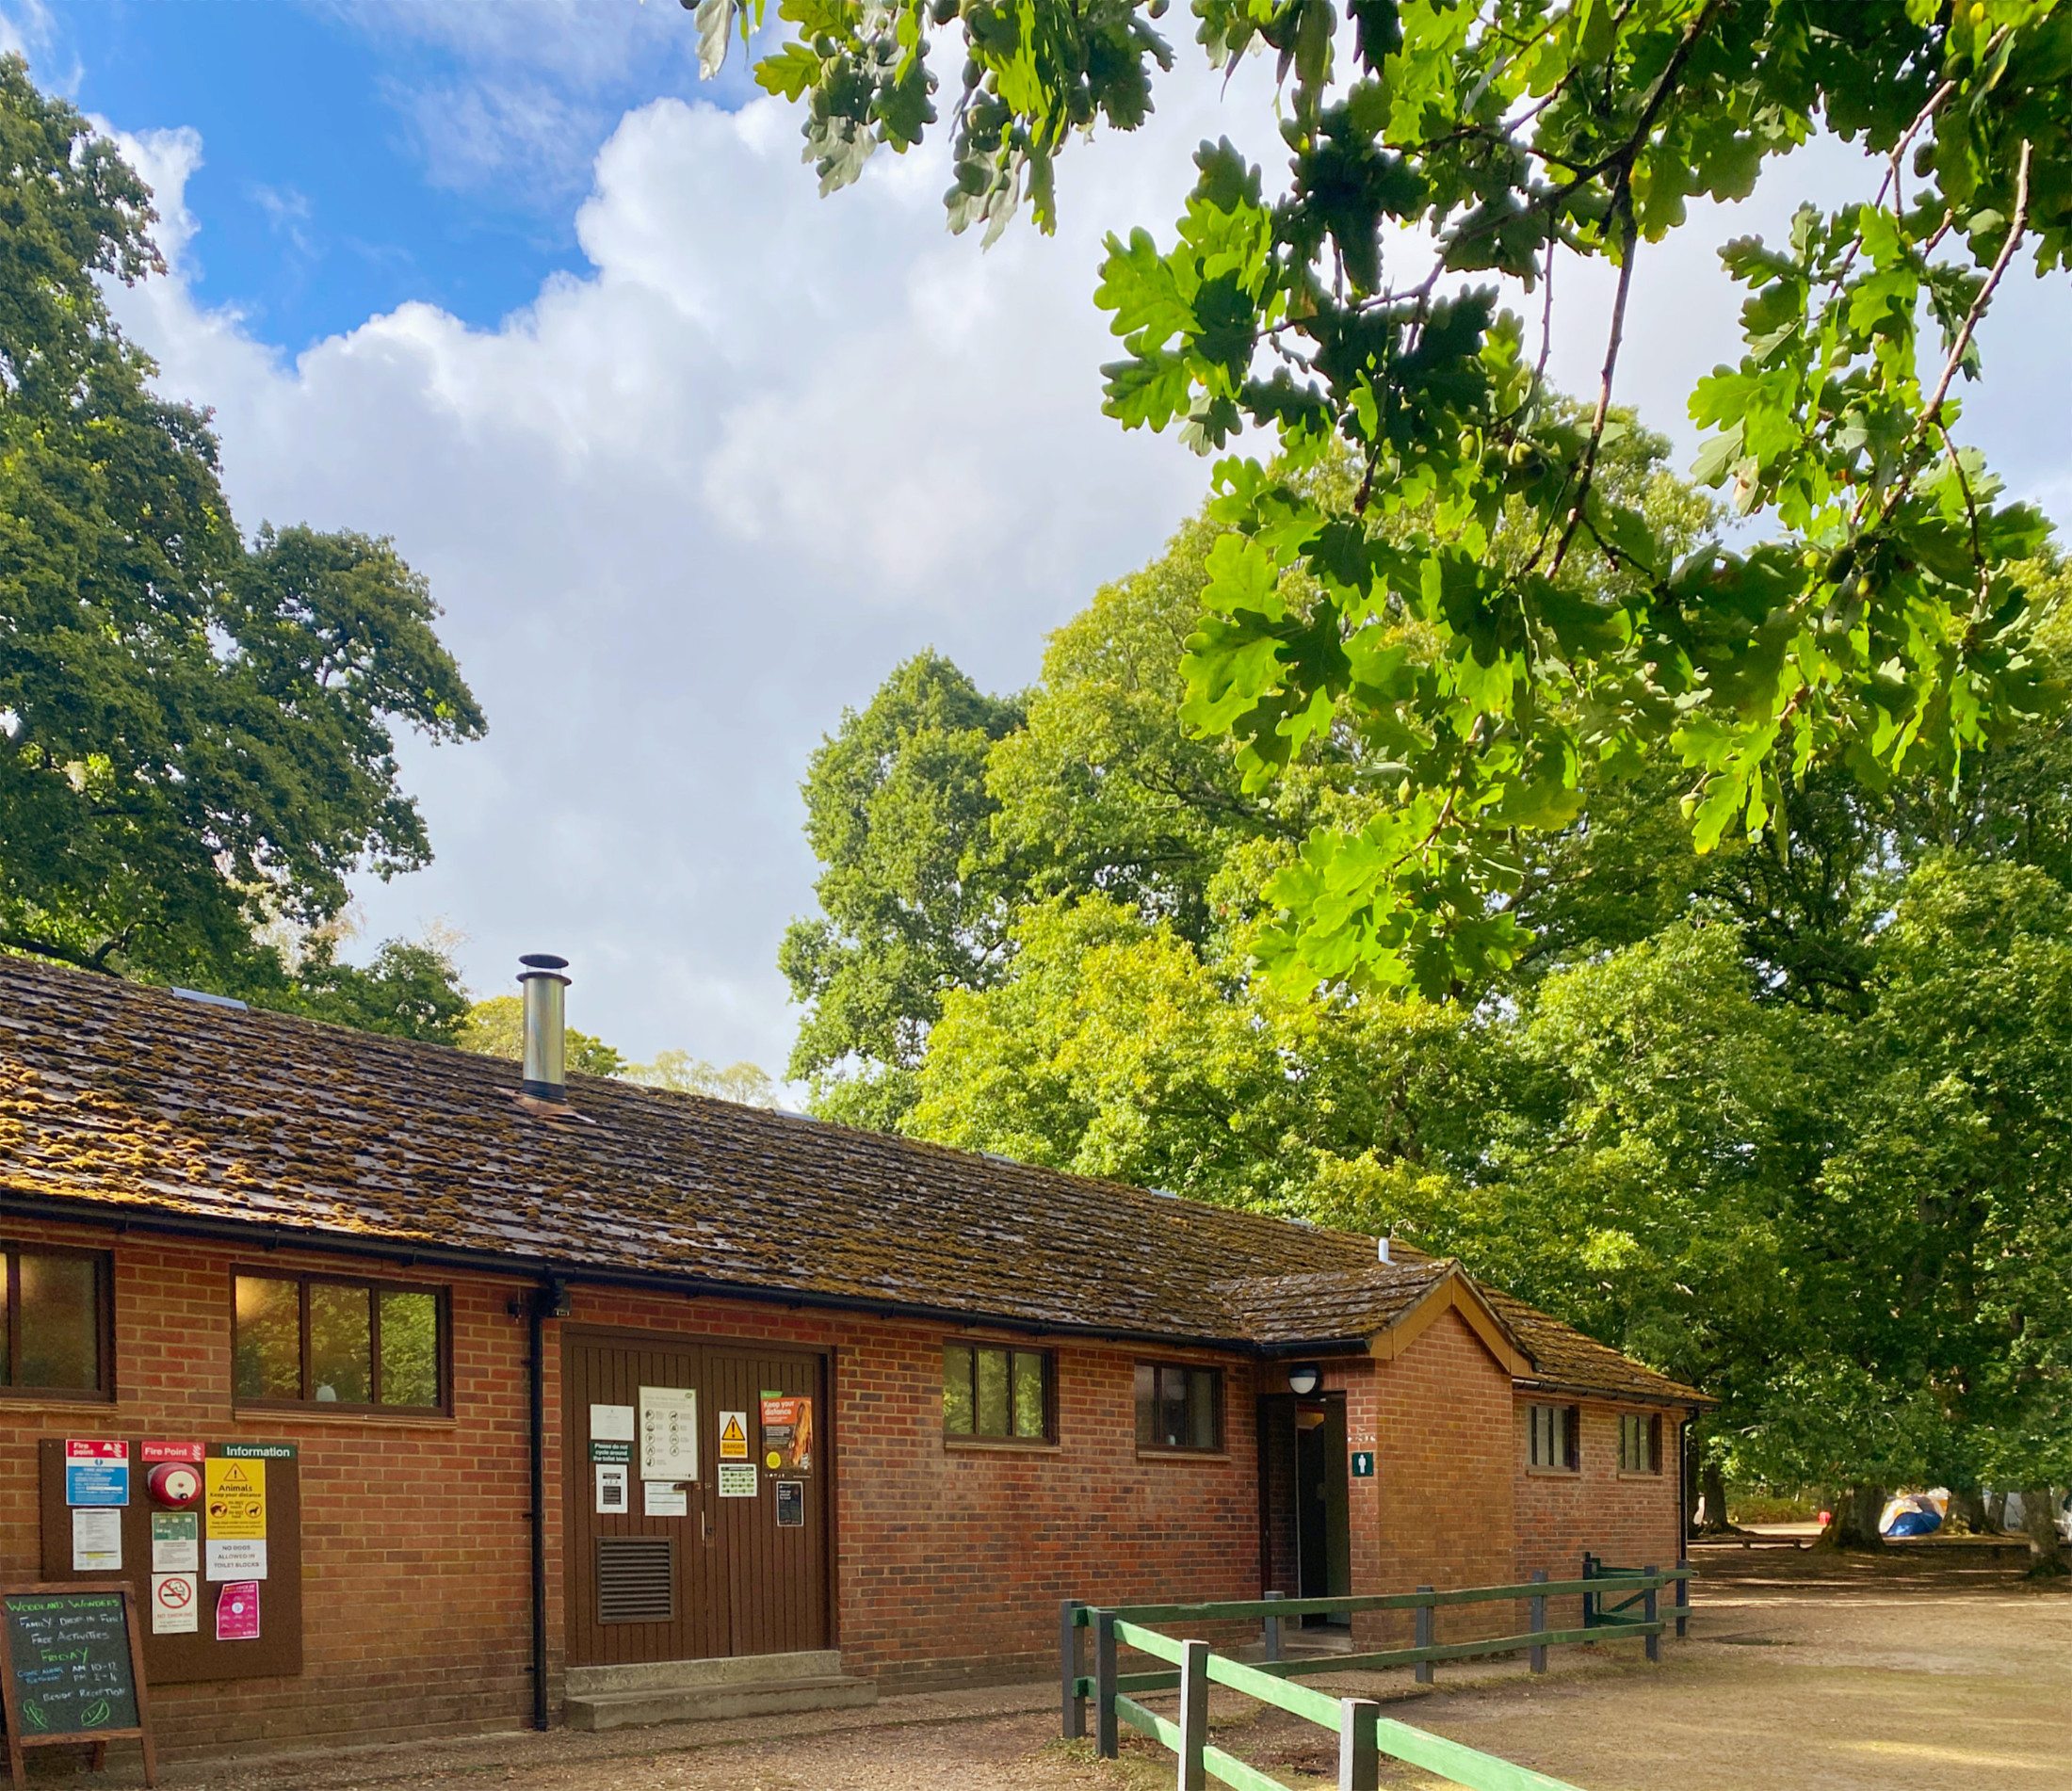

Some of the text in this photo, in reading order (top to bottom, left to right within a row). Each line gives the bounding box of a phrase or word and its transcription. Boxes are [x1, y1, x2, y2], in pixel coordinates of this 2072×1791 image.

[144, 1446, 187, 1456] Fire Point
[226, 1445, 290, 1457] Information
[6, 1601, 64, 1612] WOODLAND
[19, 1616, 52, 1629] FAMILY
[31, 1631, 110, 1645] FREE ACTIVITIES
[40, 1647, 89, 1663] FRIDAY
